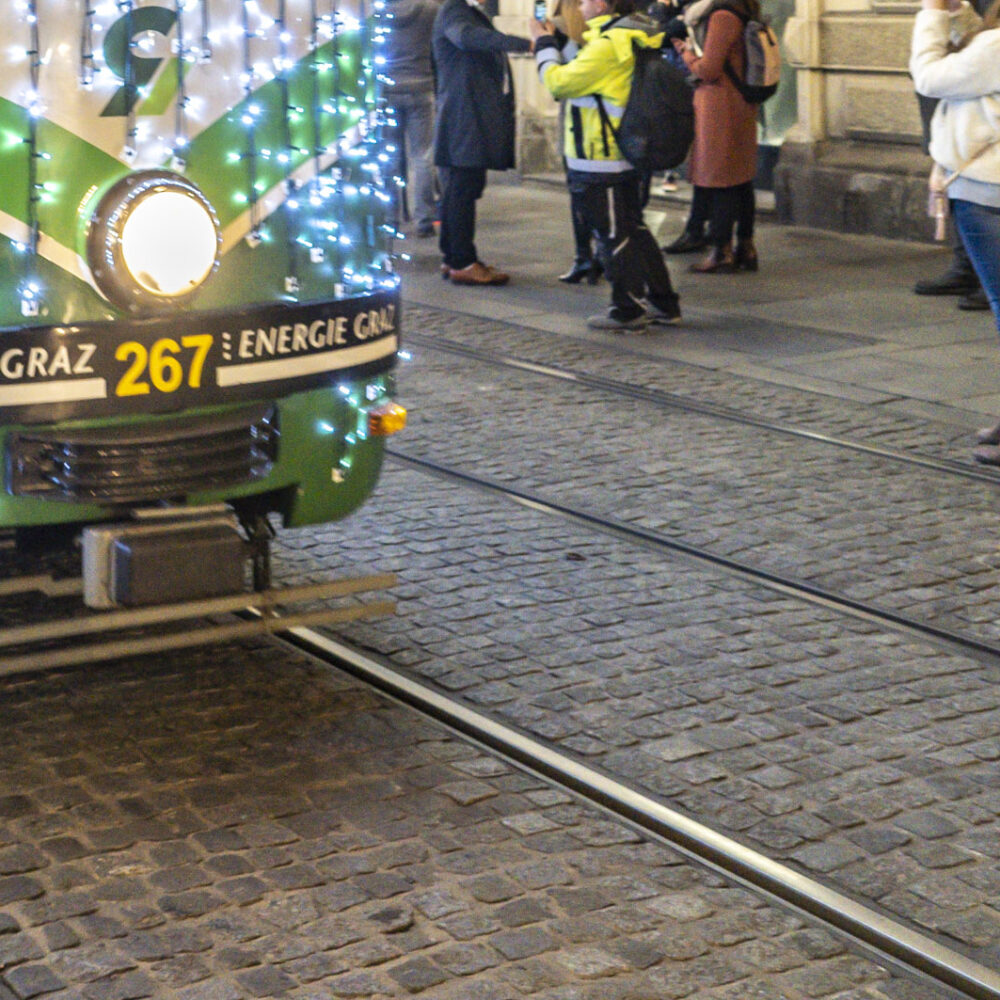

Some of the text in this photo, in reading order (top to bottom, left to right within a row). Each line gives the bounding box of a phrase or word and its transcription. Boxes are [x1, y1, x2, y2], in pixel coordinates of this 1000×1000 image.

[238, 303, 395, 359] ENERGIE GRAZ
[0, 343, 97, 380] GRAZ
[115, 334, 214, 397] 267
